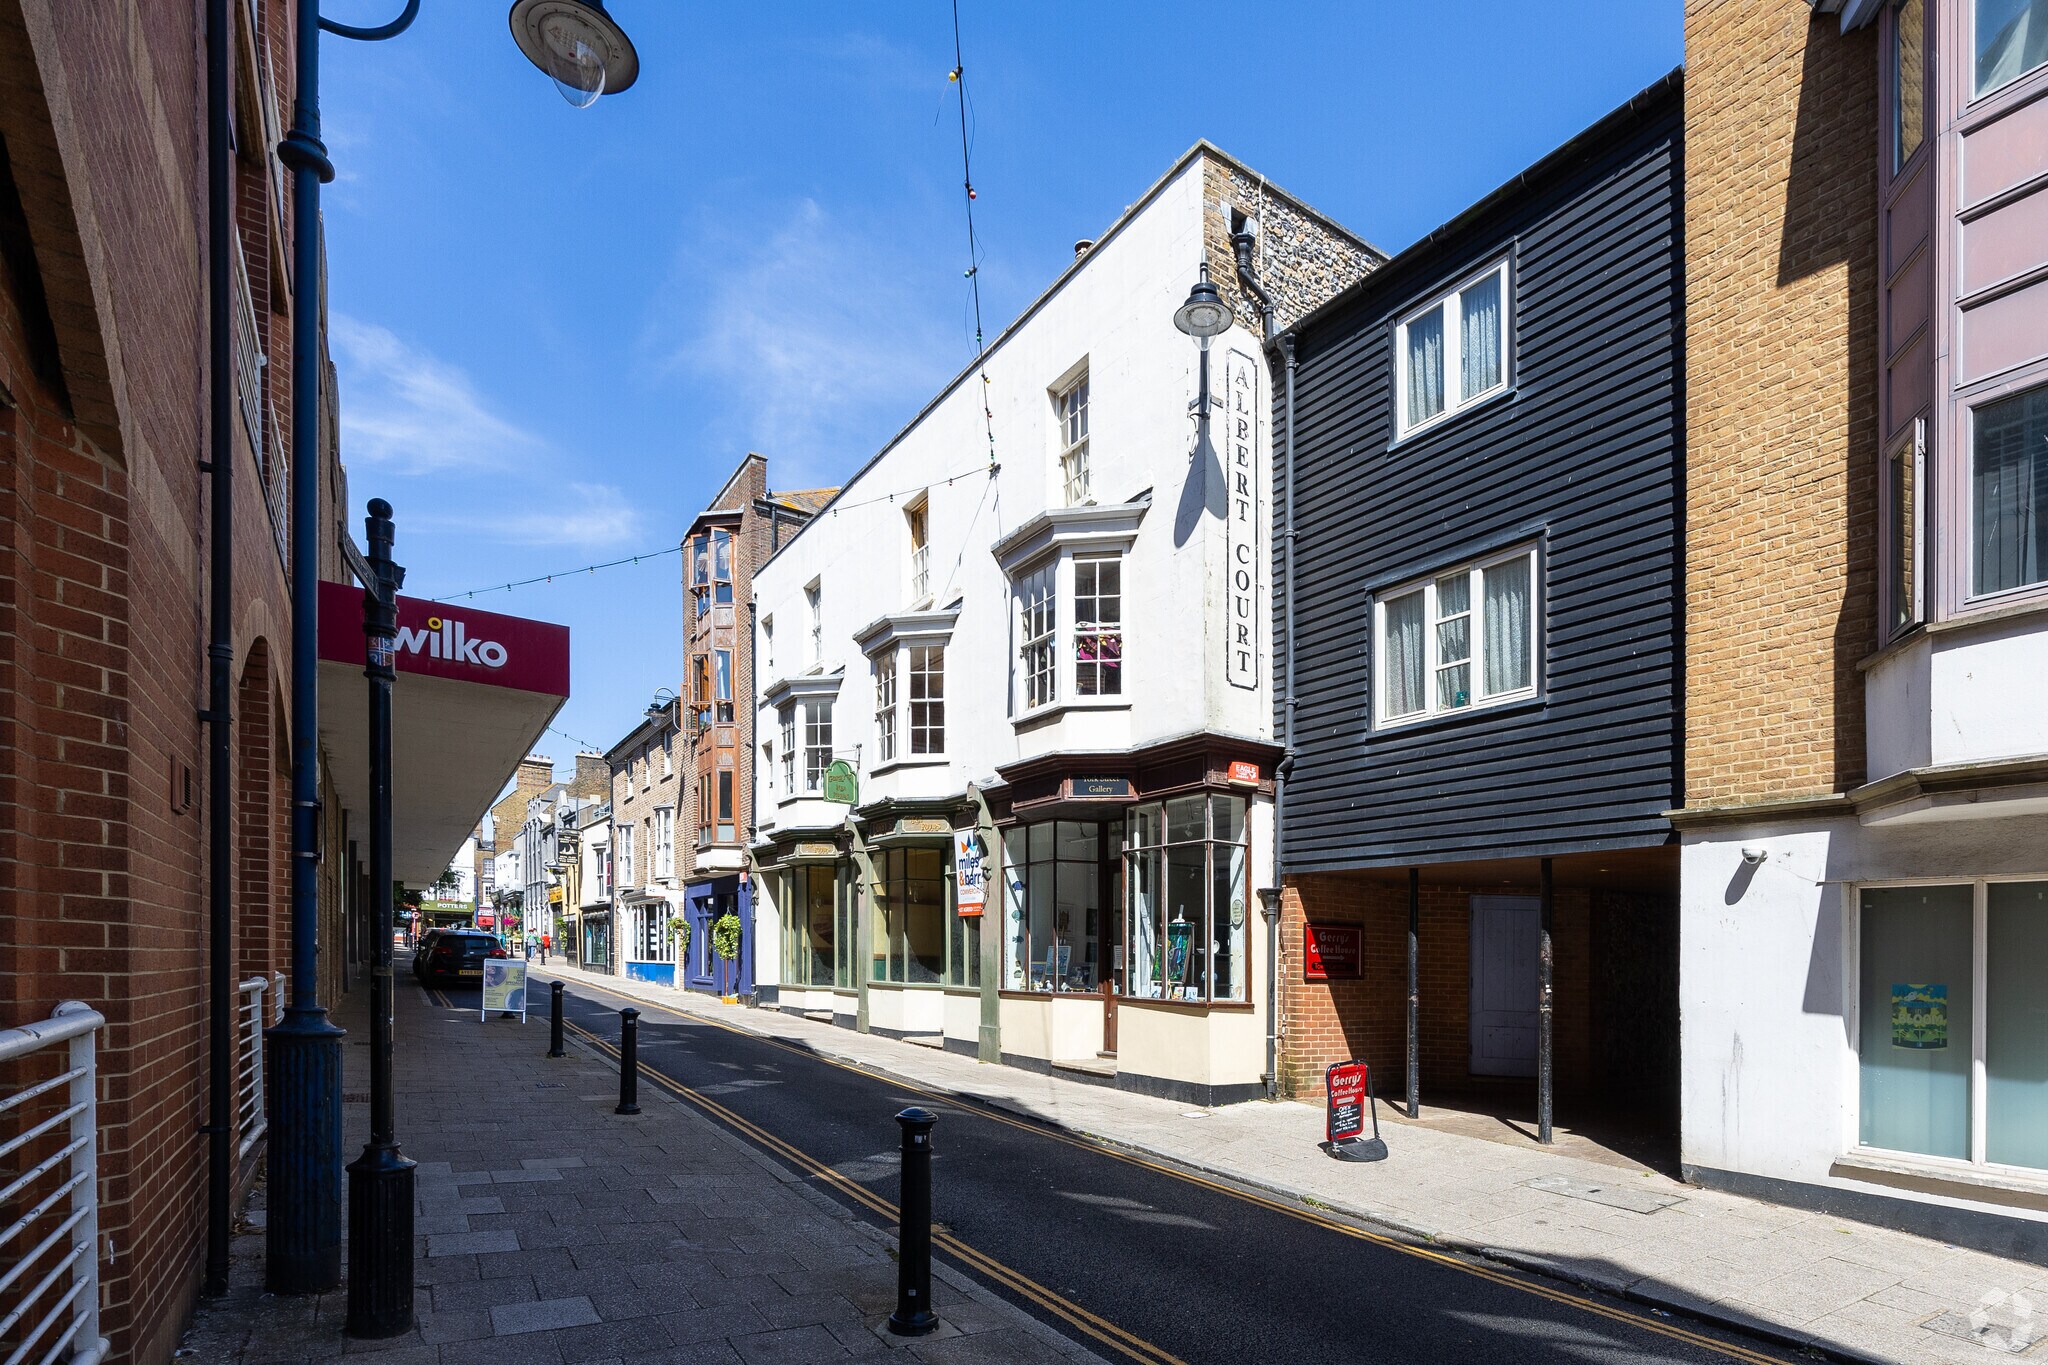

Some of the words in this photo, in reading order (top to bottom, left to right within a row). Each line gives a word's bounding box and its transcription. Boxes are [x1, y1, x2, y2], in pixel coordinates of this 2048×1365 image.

[1234, 365, 1250, 523] ALBERT
[1234, 542, 1251, 673] COURT
[393, 616, 508, 668] wilko
[1235, 764, 1257, 773] EAGLE
[1088, 785, 1114, 794] Gallery
[958, 853, 980, 870] miles
[437, 902, 468, 910] POTTERS
[1319, 931, 1350, 944] Gerry's
[1310, 943, 1334, 954] Coffee
[1334, 944, 1357, 954] House
[1898, 1013, 1944, 1026] BLOOM
[1332, 1072, 1362, 1087] Gerry's
